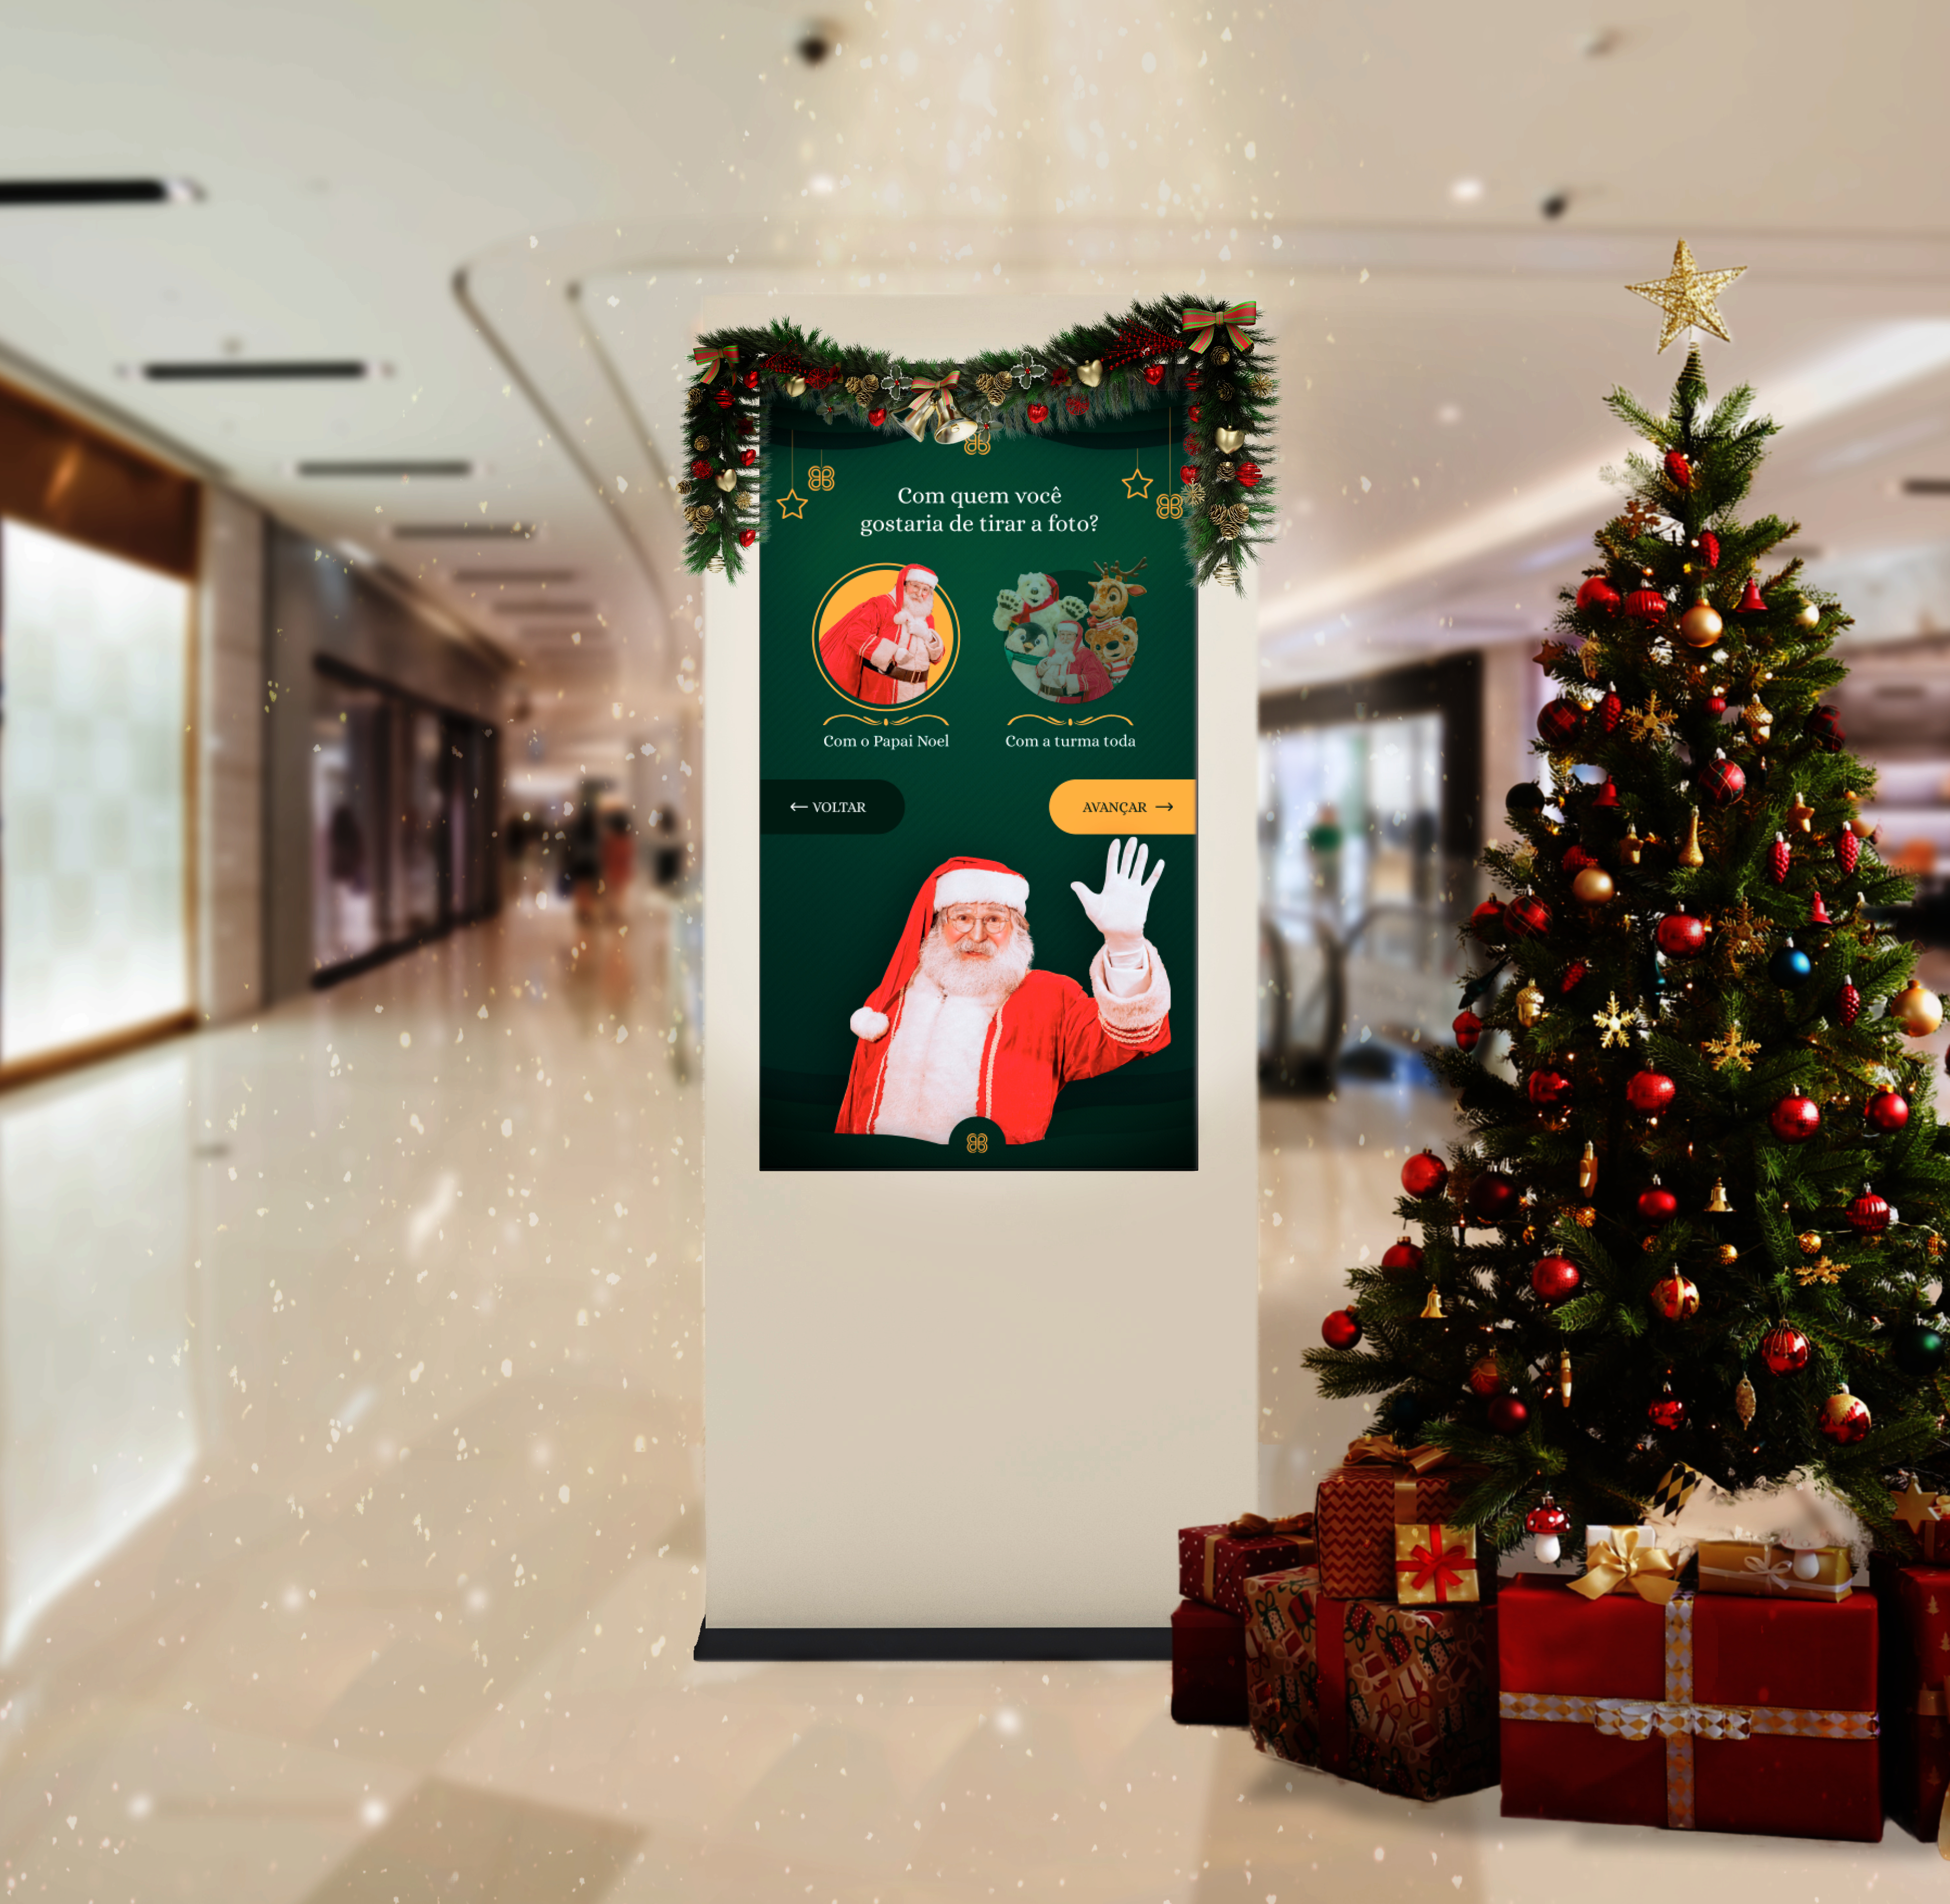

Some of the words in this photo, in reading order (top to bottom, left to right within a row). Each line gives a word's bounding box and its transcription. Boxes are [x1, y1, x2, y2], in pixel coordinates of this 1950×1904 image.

[898, 487, 945, 504] Com
[951, 491, 1009, 508] quem
[1015, 486, 1062, 504] você
[860, 514, 943, 537] gostaria
[949, 514, 973, 531] de
[979, 514, 1026, 532] tirar
[1031, 519, 1042, 531] a
[1049, 514, 1098, 532] foto?
[824, 736, 856, 747] Com
[861, 738, 869, 747] o
[874, 734, 912, 750] Papai
[917, 734, 948, 747] Noel
[1006, 736, 1039, 747] Com
[1043, 738, 1051, 747] a
[1055, 737, 1099, 747] turma
[1104, 734, 1135, 747] toda
[813, 802, 866, 812] VOLTAR
[1082, 802, 1147, 816] AVANÇAR
